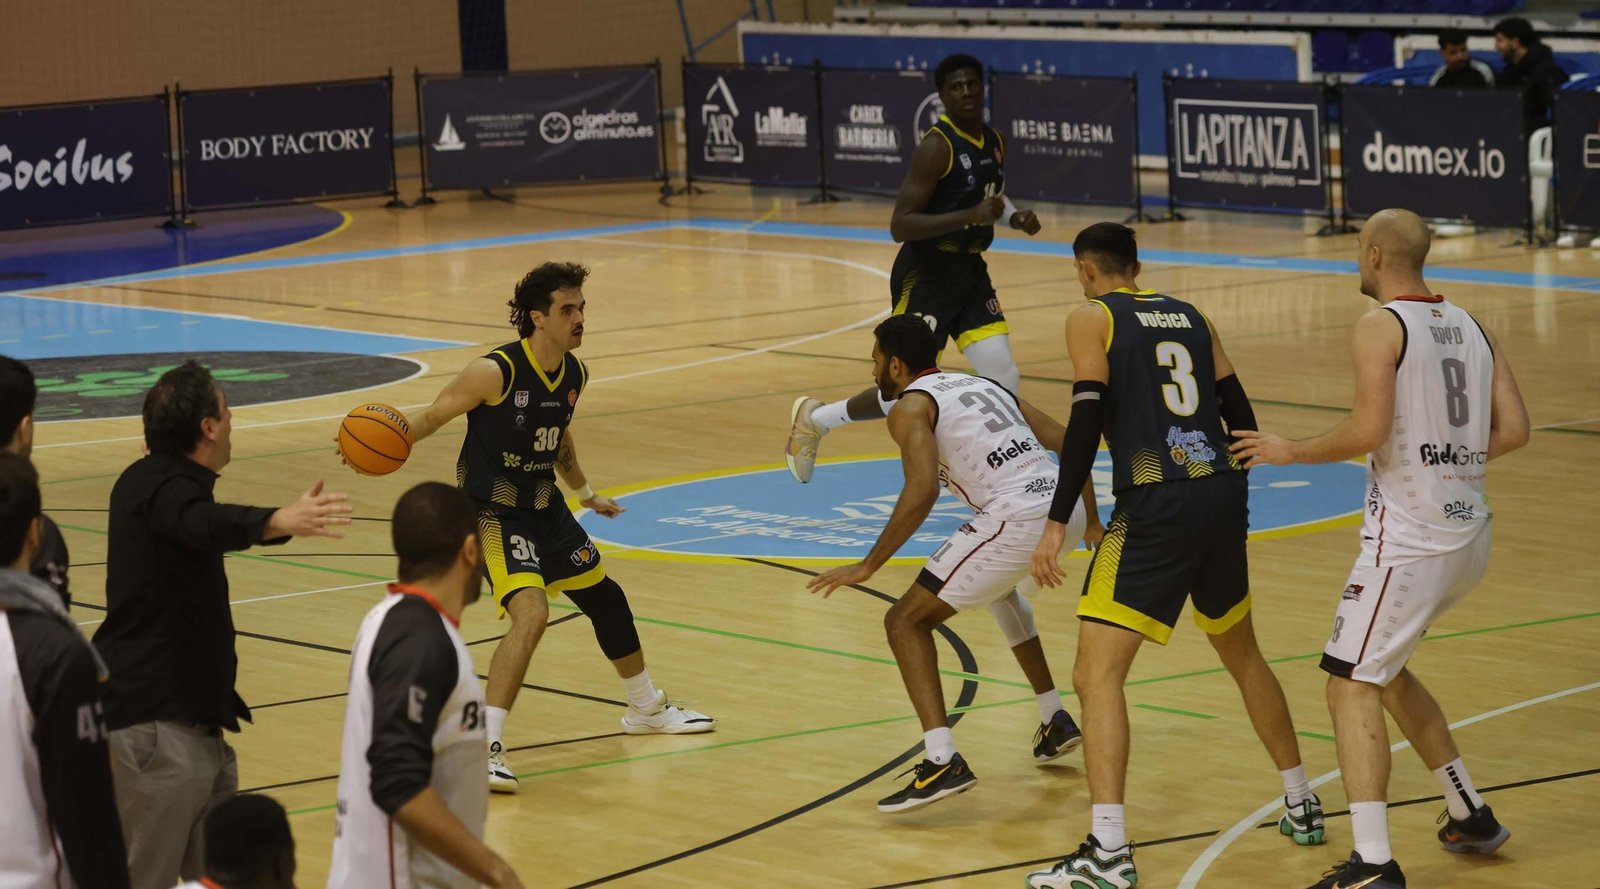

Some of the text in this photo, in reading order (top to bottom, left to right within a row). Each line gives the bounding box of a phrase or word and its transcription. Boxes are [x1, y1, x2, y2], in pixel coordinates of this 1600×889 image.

[200, 127, 375, 161] BODY FACTORY
[1012, 118, 1114, 144] IRENE BAENA
[1181, 112, 1310, 171] LAPITANZA
[1362, 130, 1506, 179] damex.io
[1134, 310, 1193, 329] VUČICA
[1155, 340, 1200, 417] 3
[1441, 357, 1470, 428] 8
[366, 405, 409, 436] Wilson
[958, 387, 1029, 434] 31
[533, 426, 560, 452] 30
[686, 505, 951, 542] Ayuntamieto
[1332, 615, 1345, 643] 8
